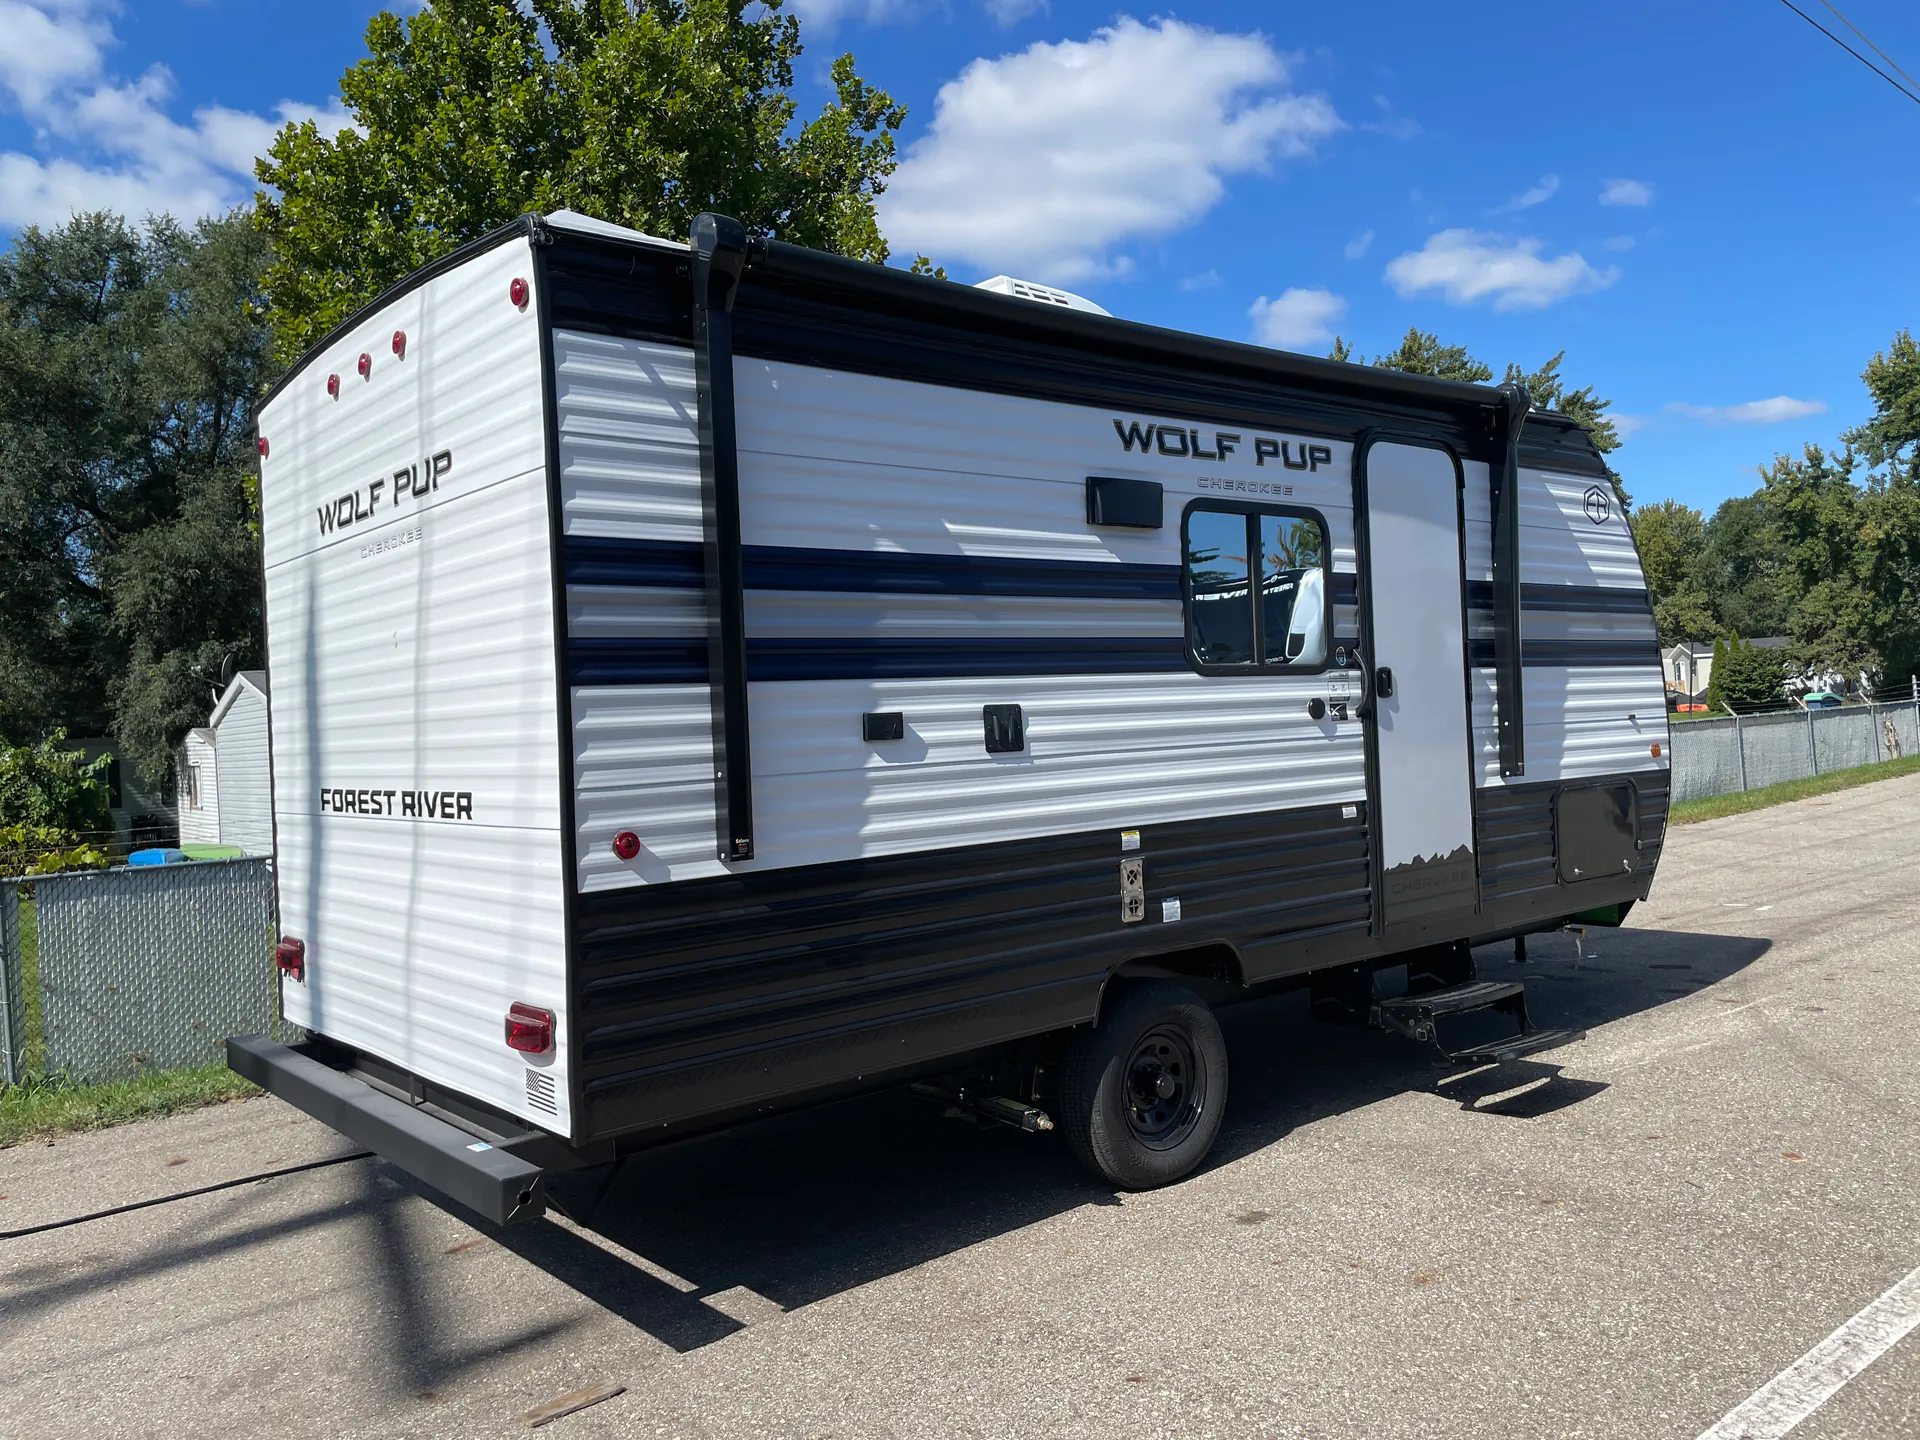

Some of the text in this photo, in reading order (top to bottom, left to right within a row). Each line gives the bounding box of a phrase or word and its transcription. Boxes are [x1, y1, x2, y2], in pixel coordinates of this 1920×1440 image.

[1113, 419, 1332, 472] WOLF PUP
[316, 448, 453, 536] WOLF PUP
[1197, 477, 1293, 496] CHEROKEE
[360, 526, 423, 560] CHEROKEE
[320, 788, 473, 820] FOREST RIVER
[1391, 869, 1470, 895] CHEROKEE
